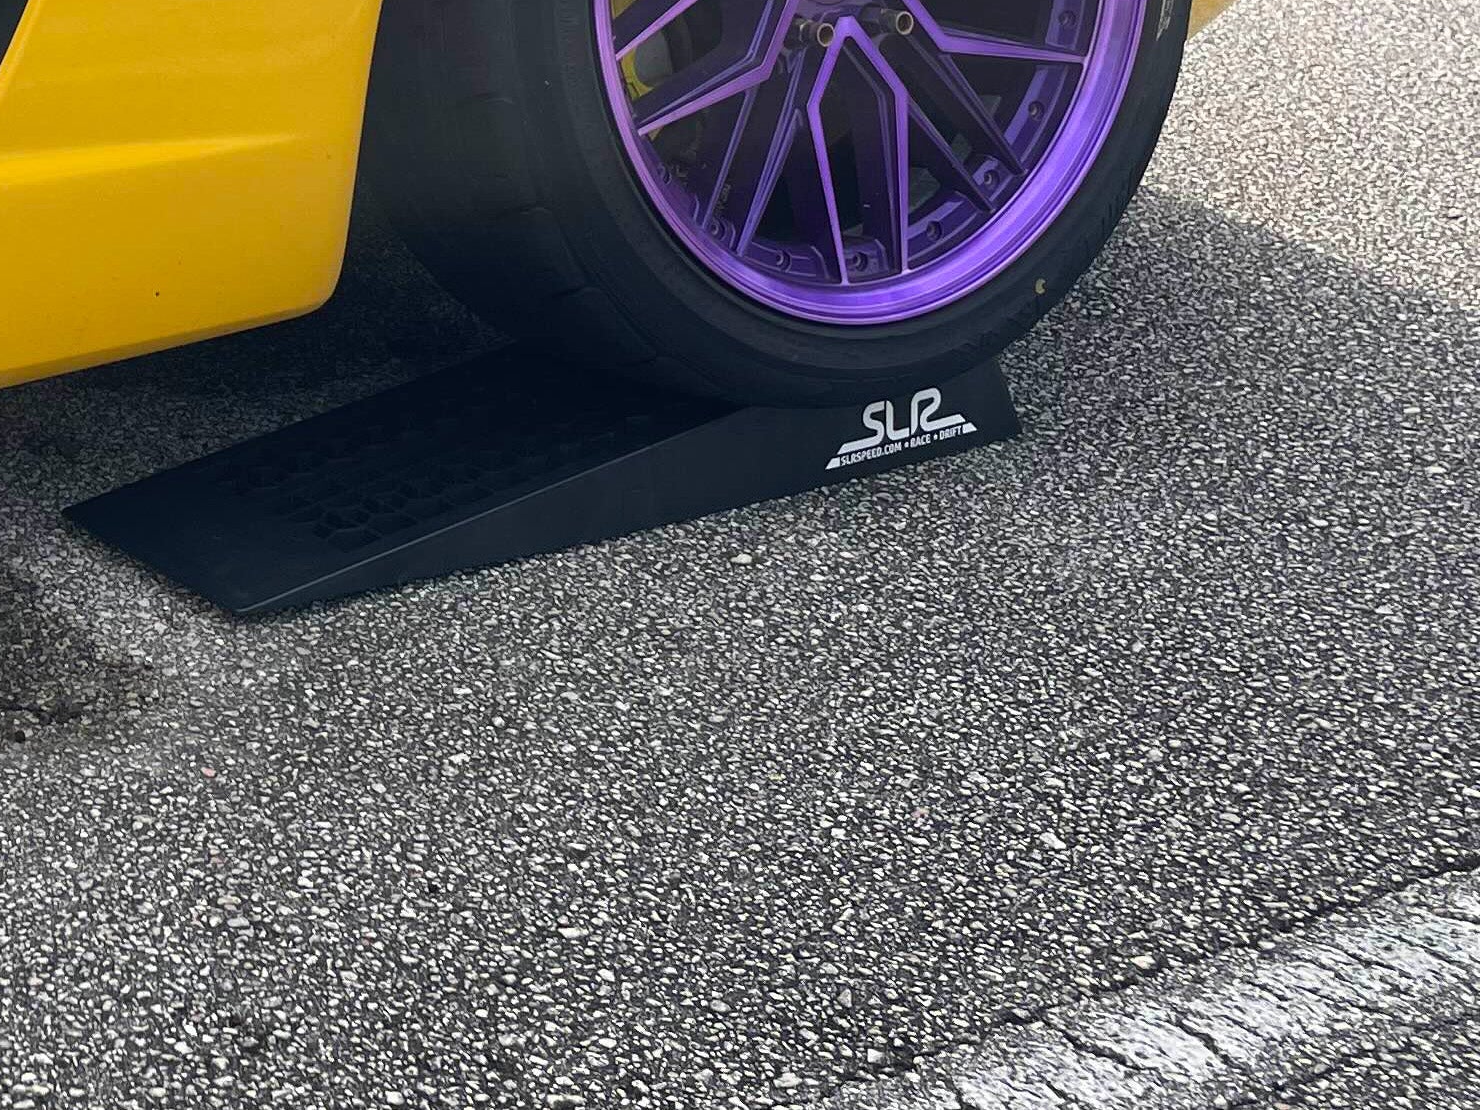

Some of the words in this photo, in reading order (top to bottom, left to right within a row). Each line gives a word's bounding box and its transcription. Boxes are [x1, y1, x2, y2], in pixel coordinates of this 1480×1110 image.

[837, 388, 966, 455] SLR
[840, 442, 902, 466] SLRSPEED.COM
[910, 433, 931, 448] RACE
[939, 424, 962, 440] DRIFT
